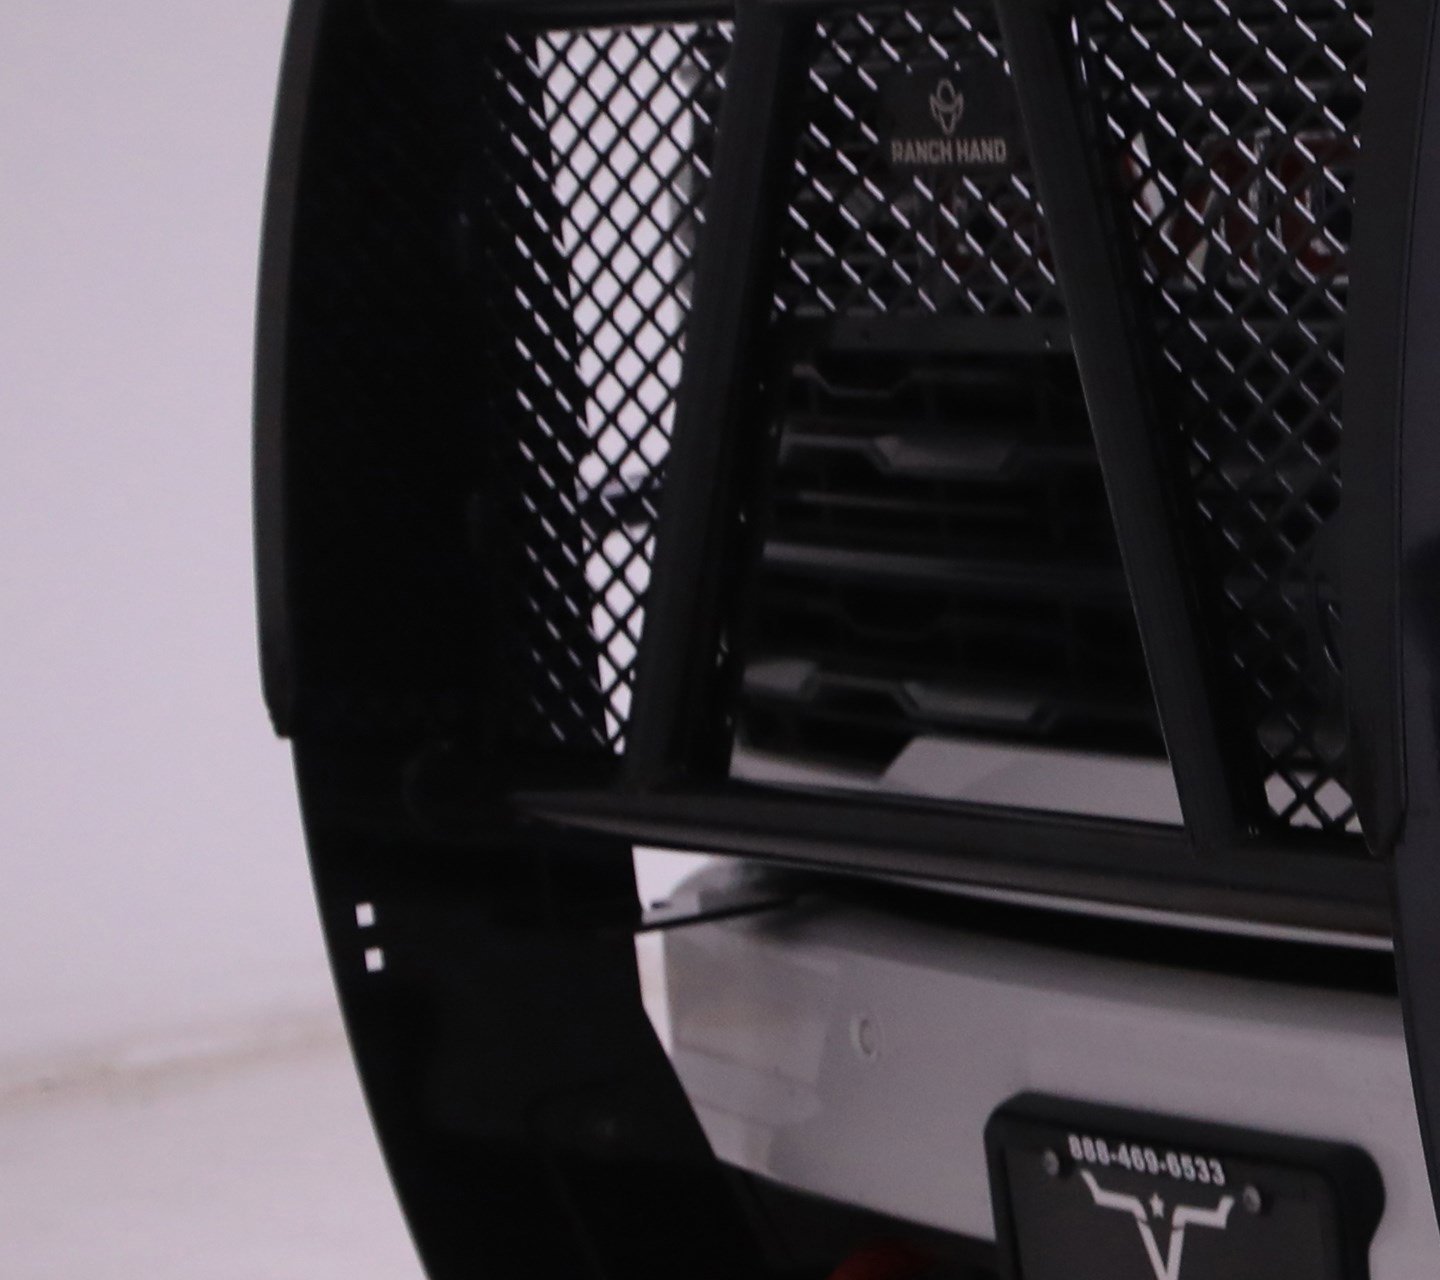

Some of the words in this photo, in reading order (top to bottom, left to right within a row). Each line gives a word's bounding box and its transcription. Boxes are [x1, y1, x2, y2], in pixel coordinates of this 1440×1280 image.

[891, 138, 951, 164] RANCH
[957, 138, 1007, 164] HAND
[1068, 1134, 1225, 1186] 888-469-6533
